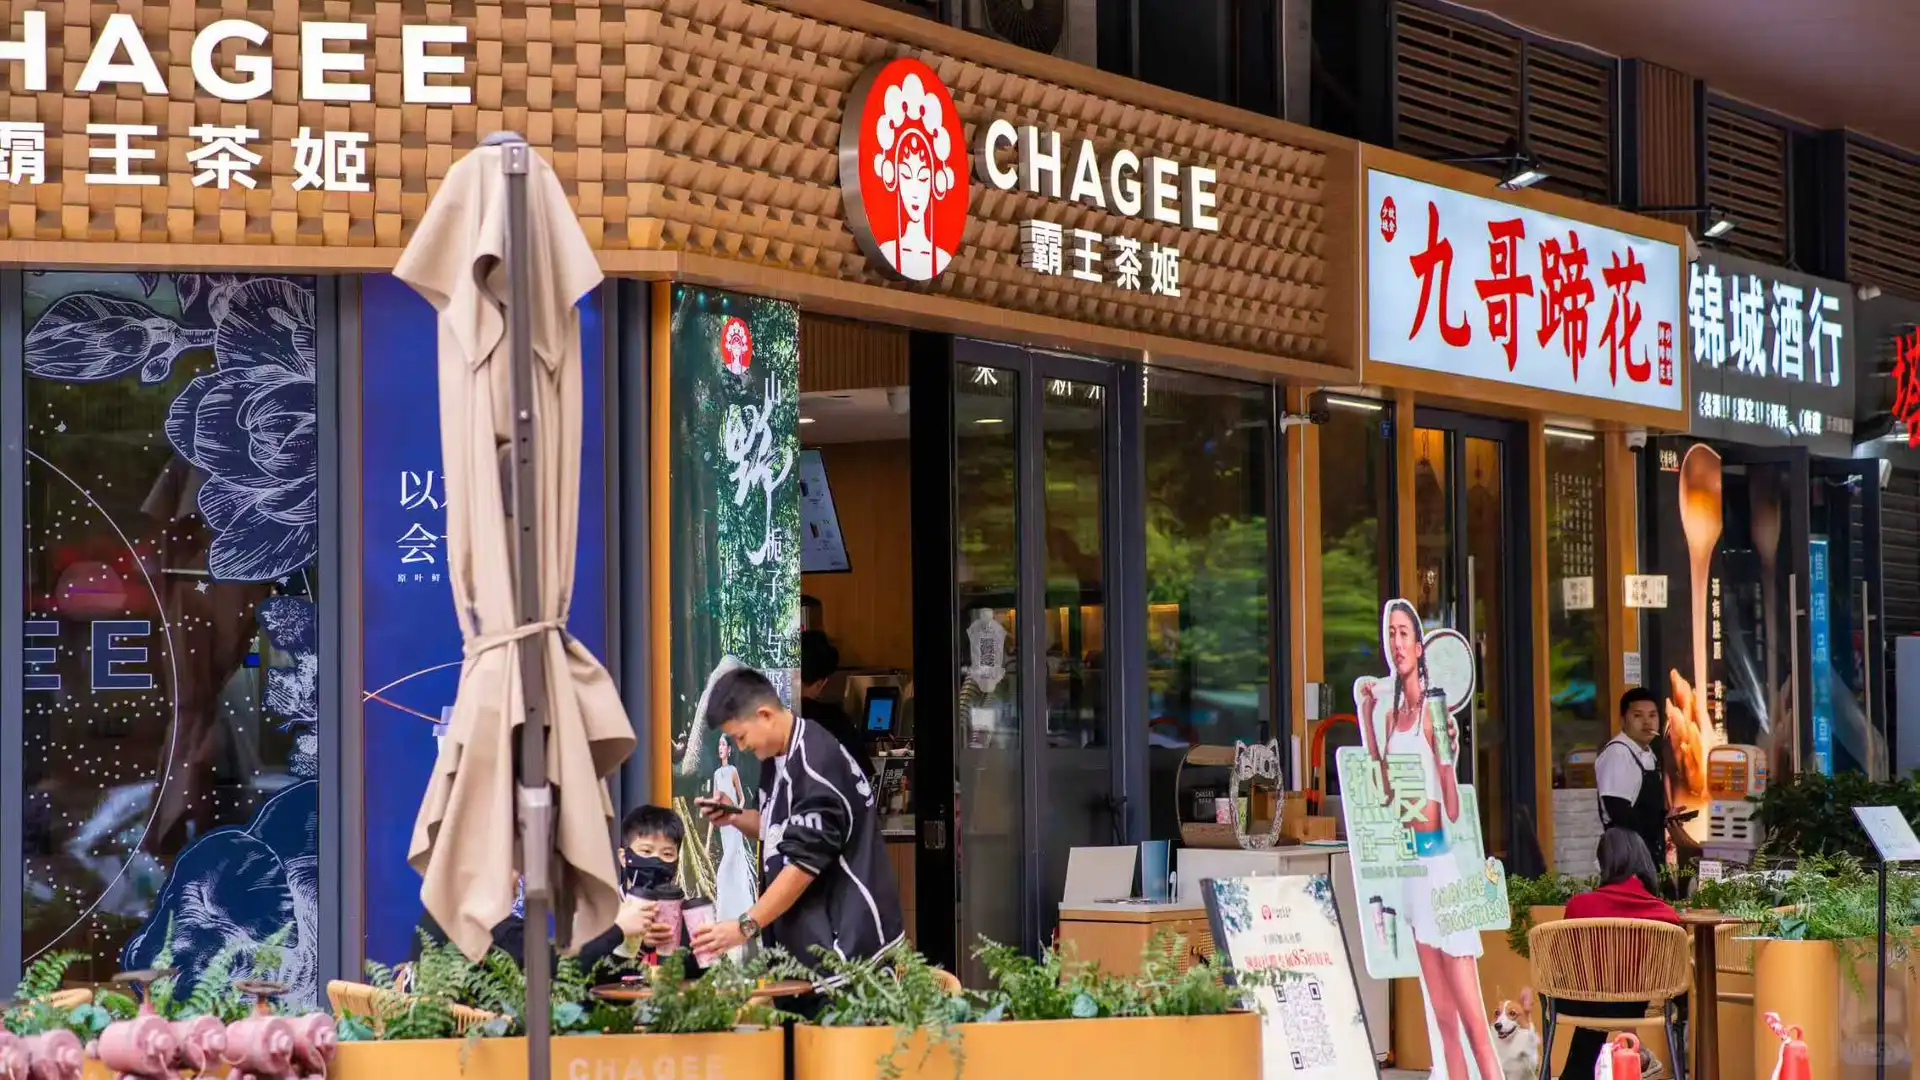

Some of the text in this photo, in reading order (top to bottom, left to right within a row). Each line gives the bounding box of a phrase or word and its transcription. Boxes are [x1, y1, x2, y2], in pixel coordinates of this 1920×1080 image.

[0, 122, 370, 192] 霸王茶姬
[985, 119, 1219, 231] CHAGEE
[1022, 219, 1181, 298] 霸王茶姬
[1409, 201, 1651, 387] 九哥蹄花
[1688, 262, 1843, 387] 锦城酒行
[400, 470, 448, 510] 以
[396, 522, 448, 564] 会
